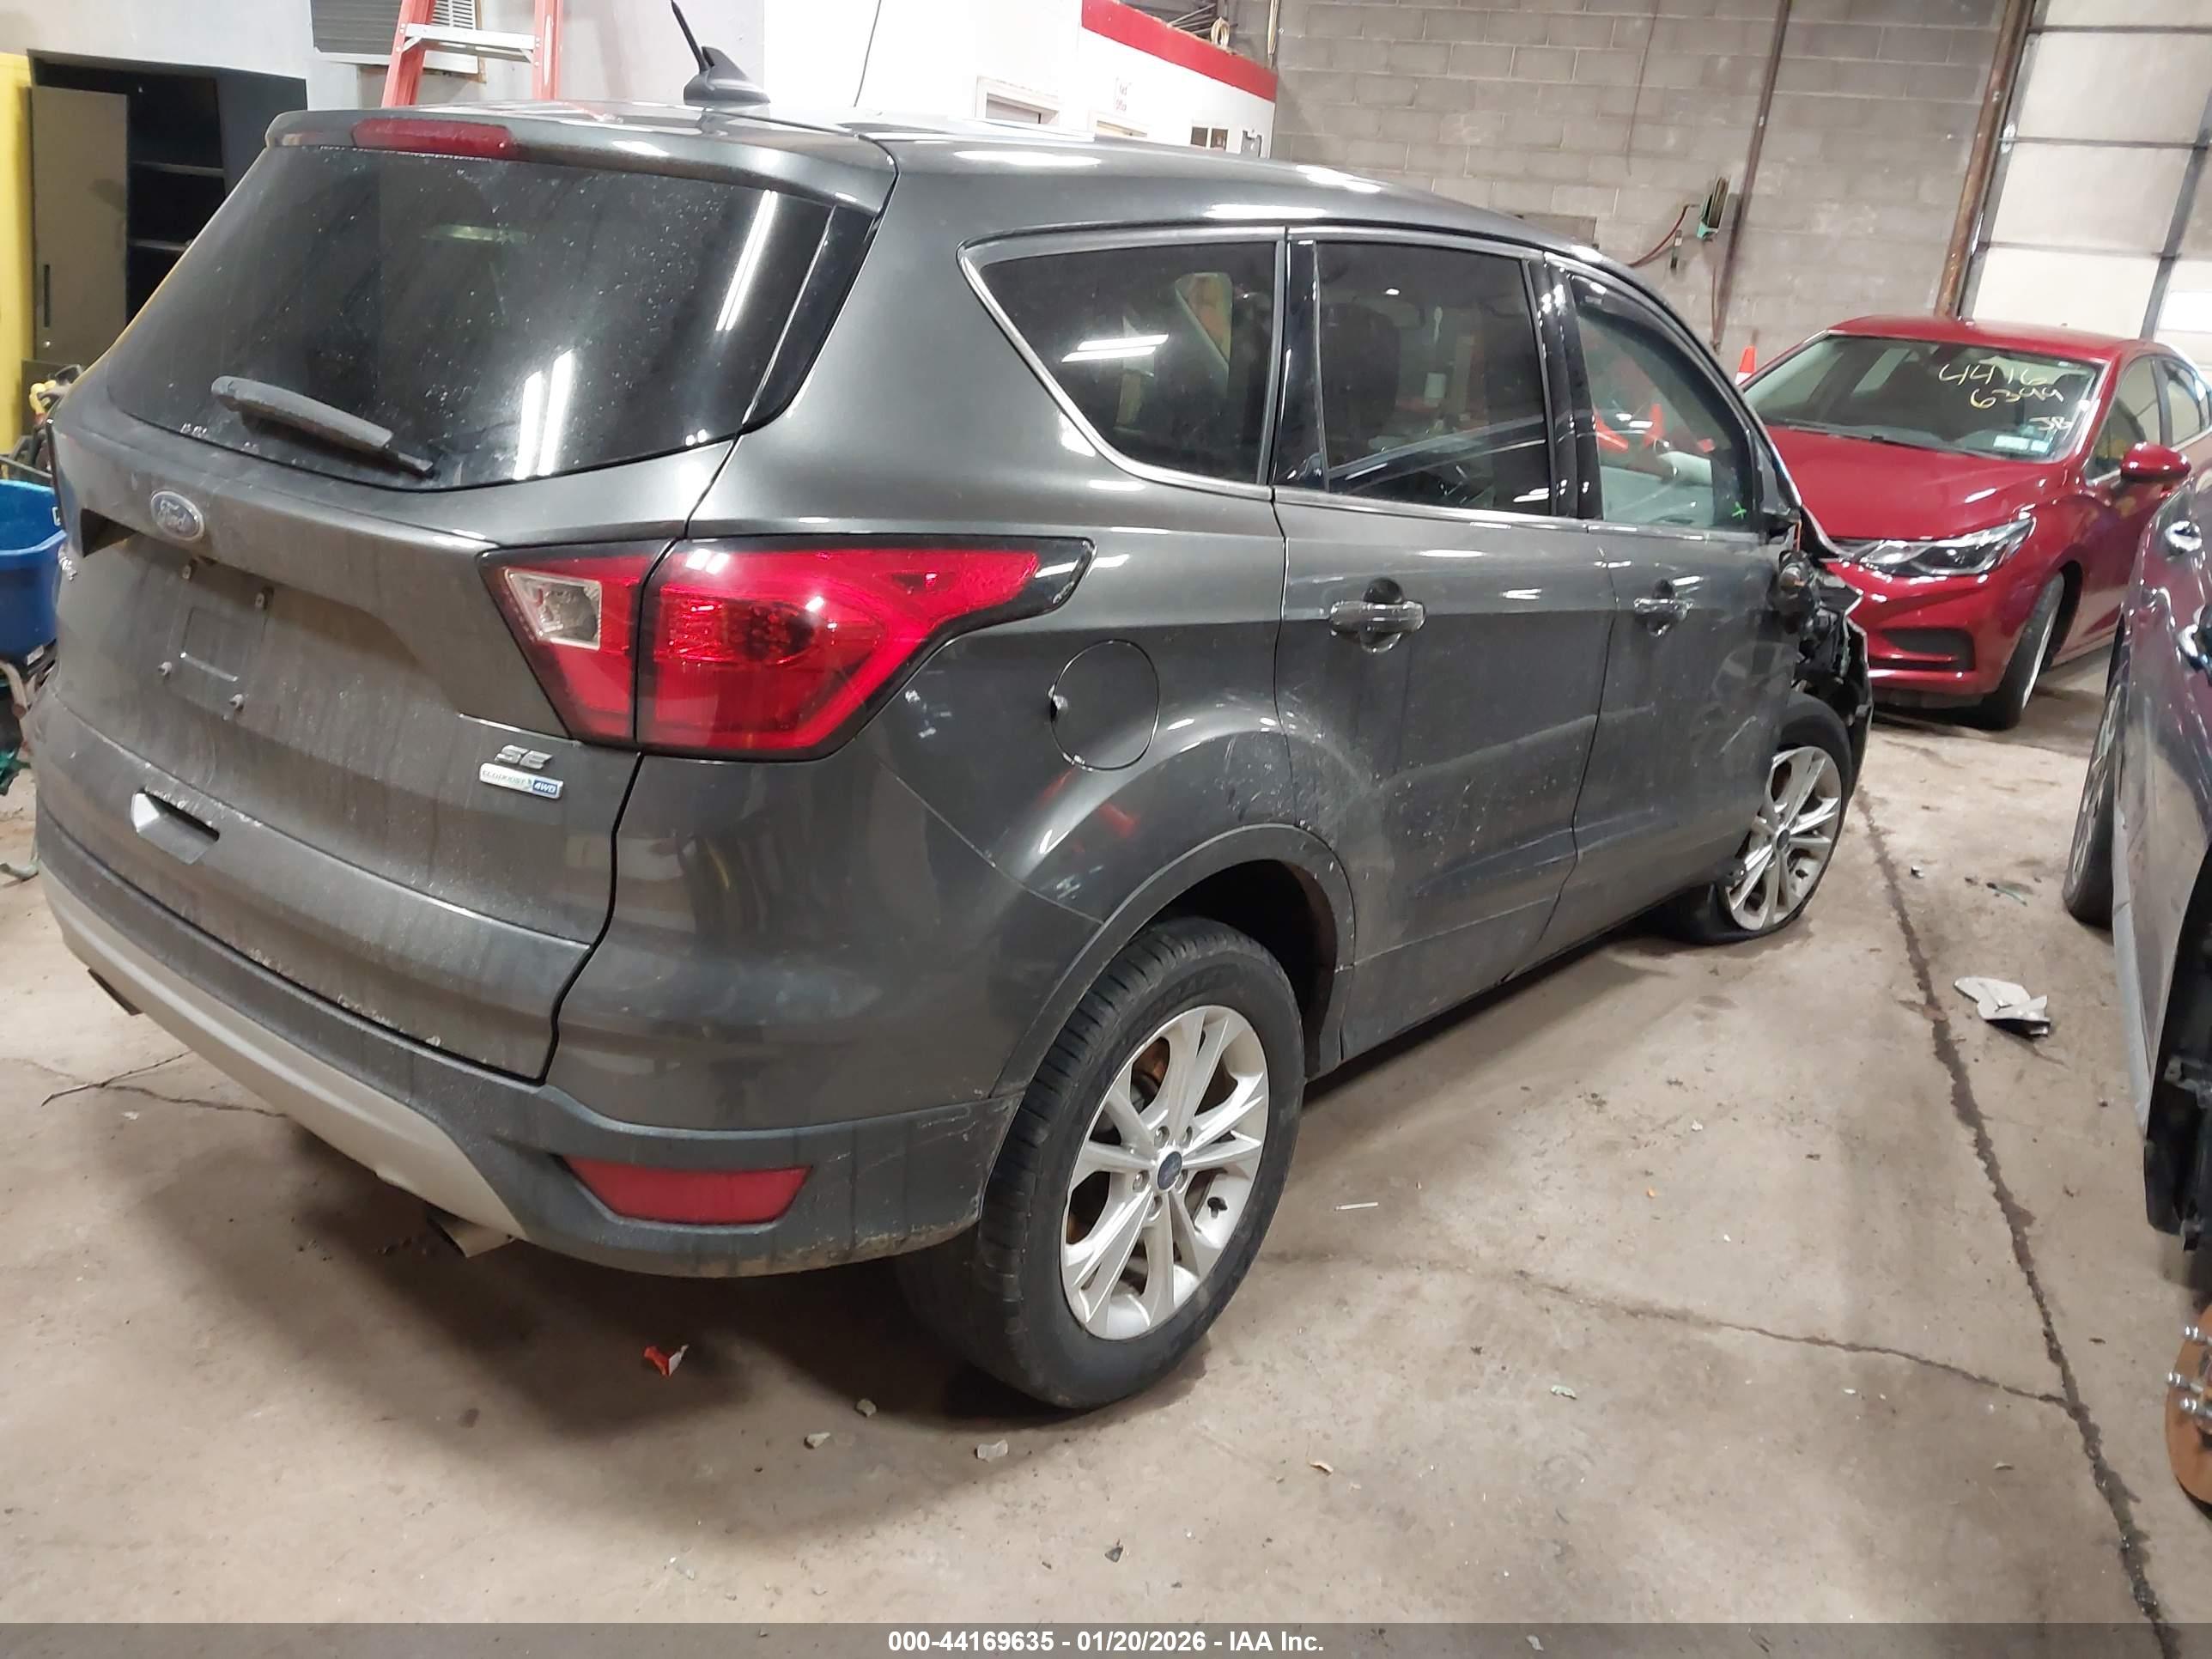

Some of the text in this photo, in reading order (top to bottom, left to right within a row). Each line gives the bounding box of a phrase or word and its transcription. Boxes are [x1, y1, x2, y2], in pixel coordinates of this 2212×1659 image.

[1938, 362, 2047, 386] 4416
[494, 744, 554, 770] SE
[534, 781, 557, 793] 4WD
